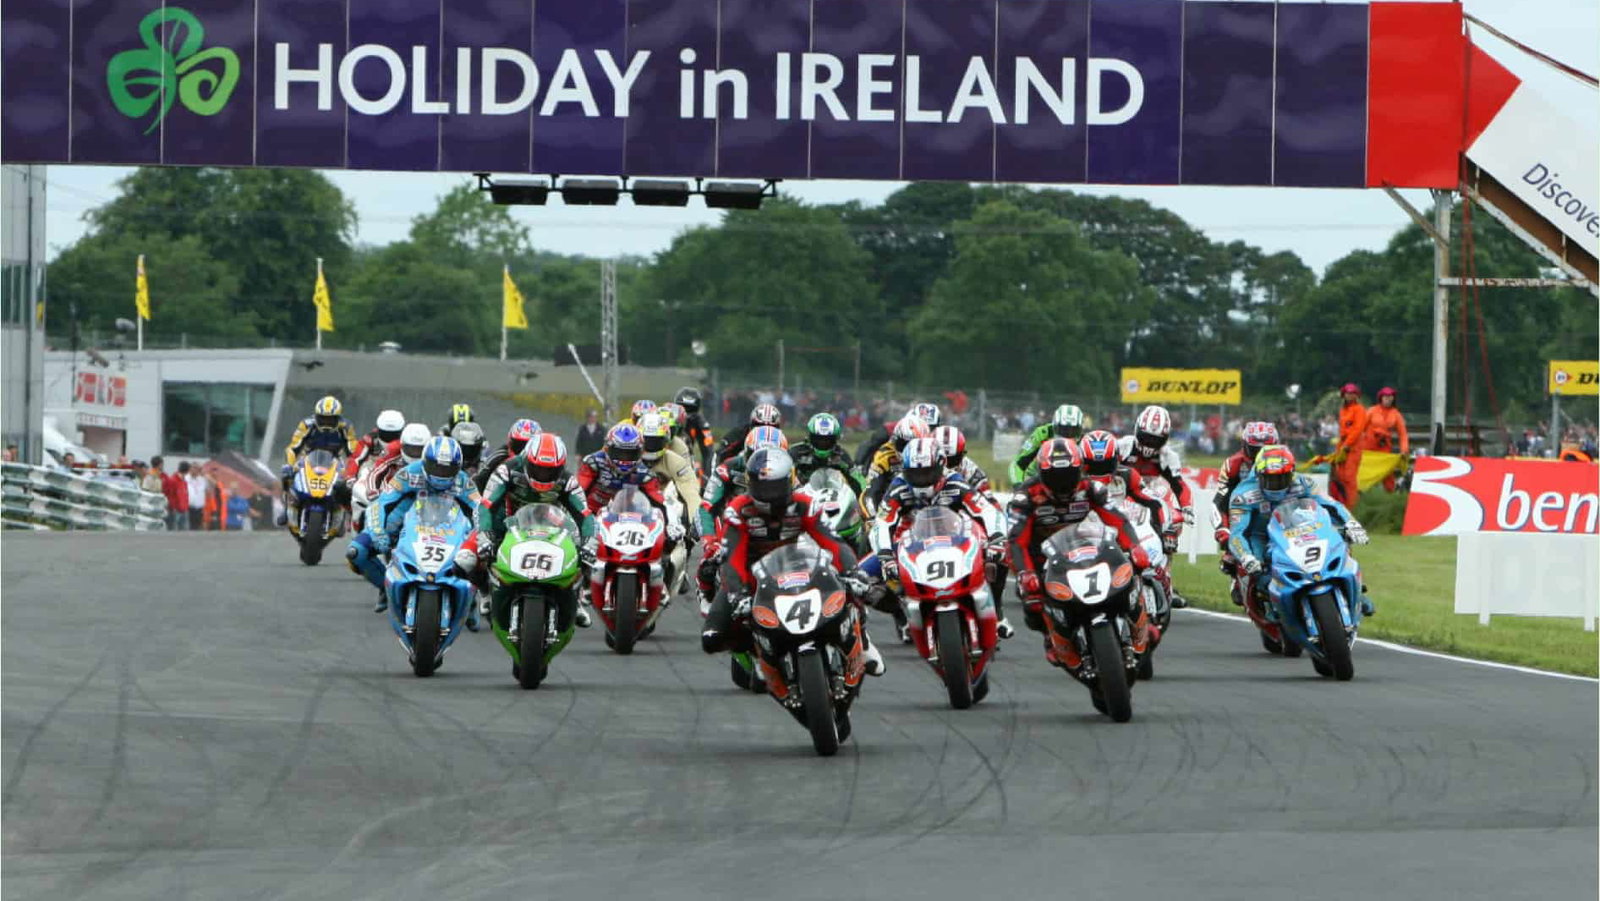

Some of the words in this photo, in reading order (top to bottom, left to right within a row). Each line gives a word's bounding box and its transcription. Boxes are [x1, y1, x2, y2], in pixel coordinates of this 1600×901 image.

[275, 42, 651, 116] HOLIDAY
[680, 48, 748, 119] in
[776, 52, 1145, 125] IRELAND
[1522, 163, 1599, 238] Discove
[1147, 381, 1237, 395] DUNLOP
[310, 478, 328, 490] 56
[1497, 472, 1599, 533] ben
[616, 530, 645, 546] 36
[421, 546, 446, 562] 35
[521, 553, 553, 571] 66
[1304, 546, 1322, 565] 9
[926, 561, 955, 581] 91
[1084, 571, 1102, 598] 1
[784, 599, 816, 630] 4
